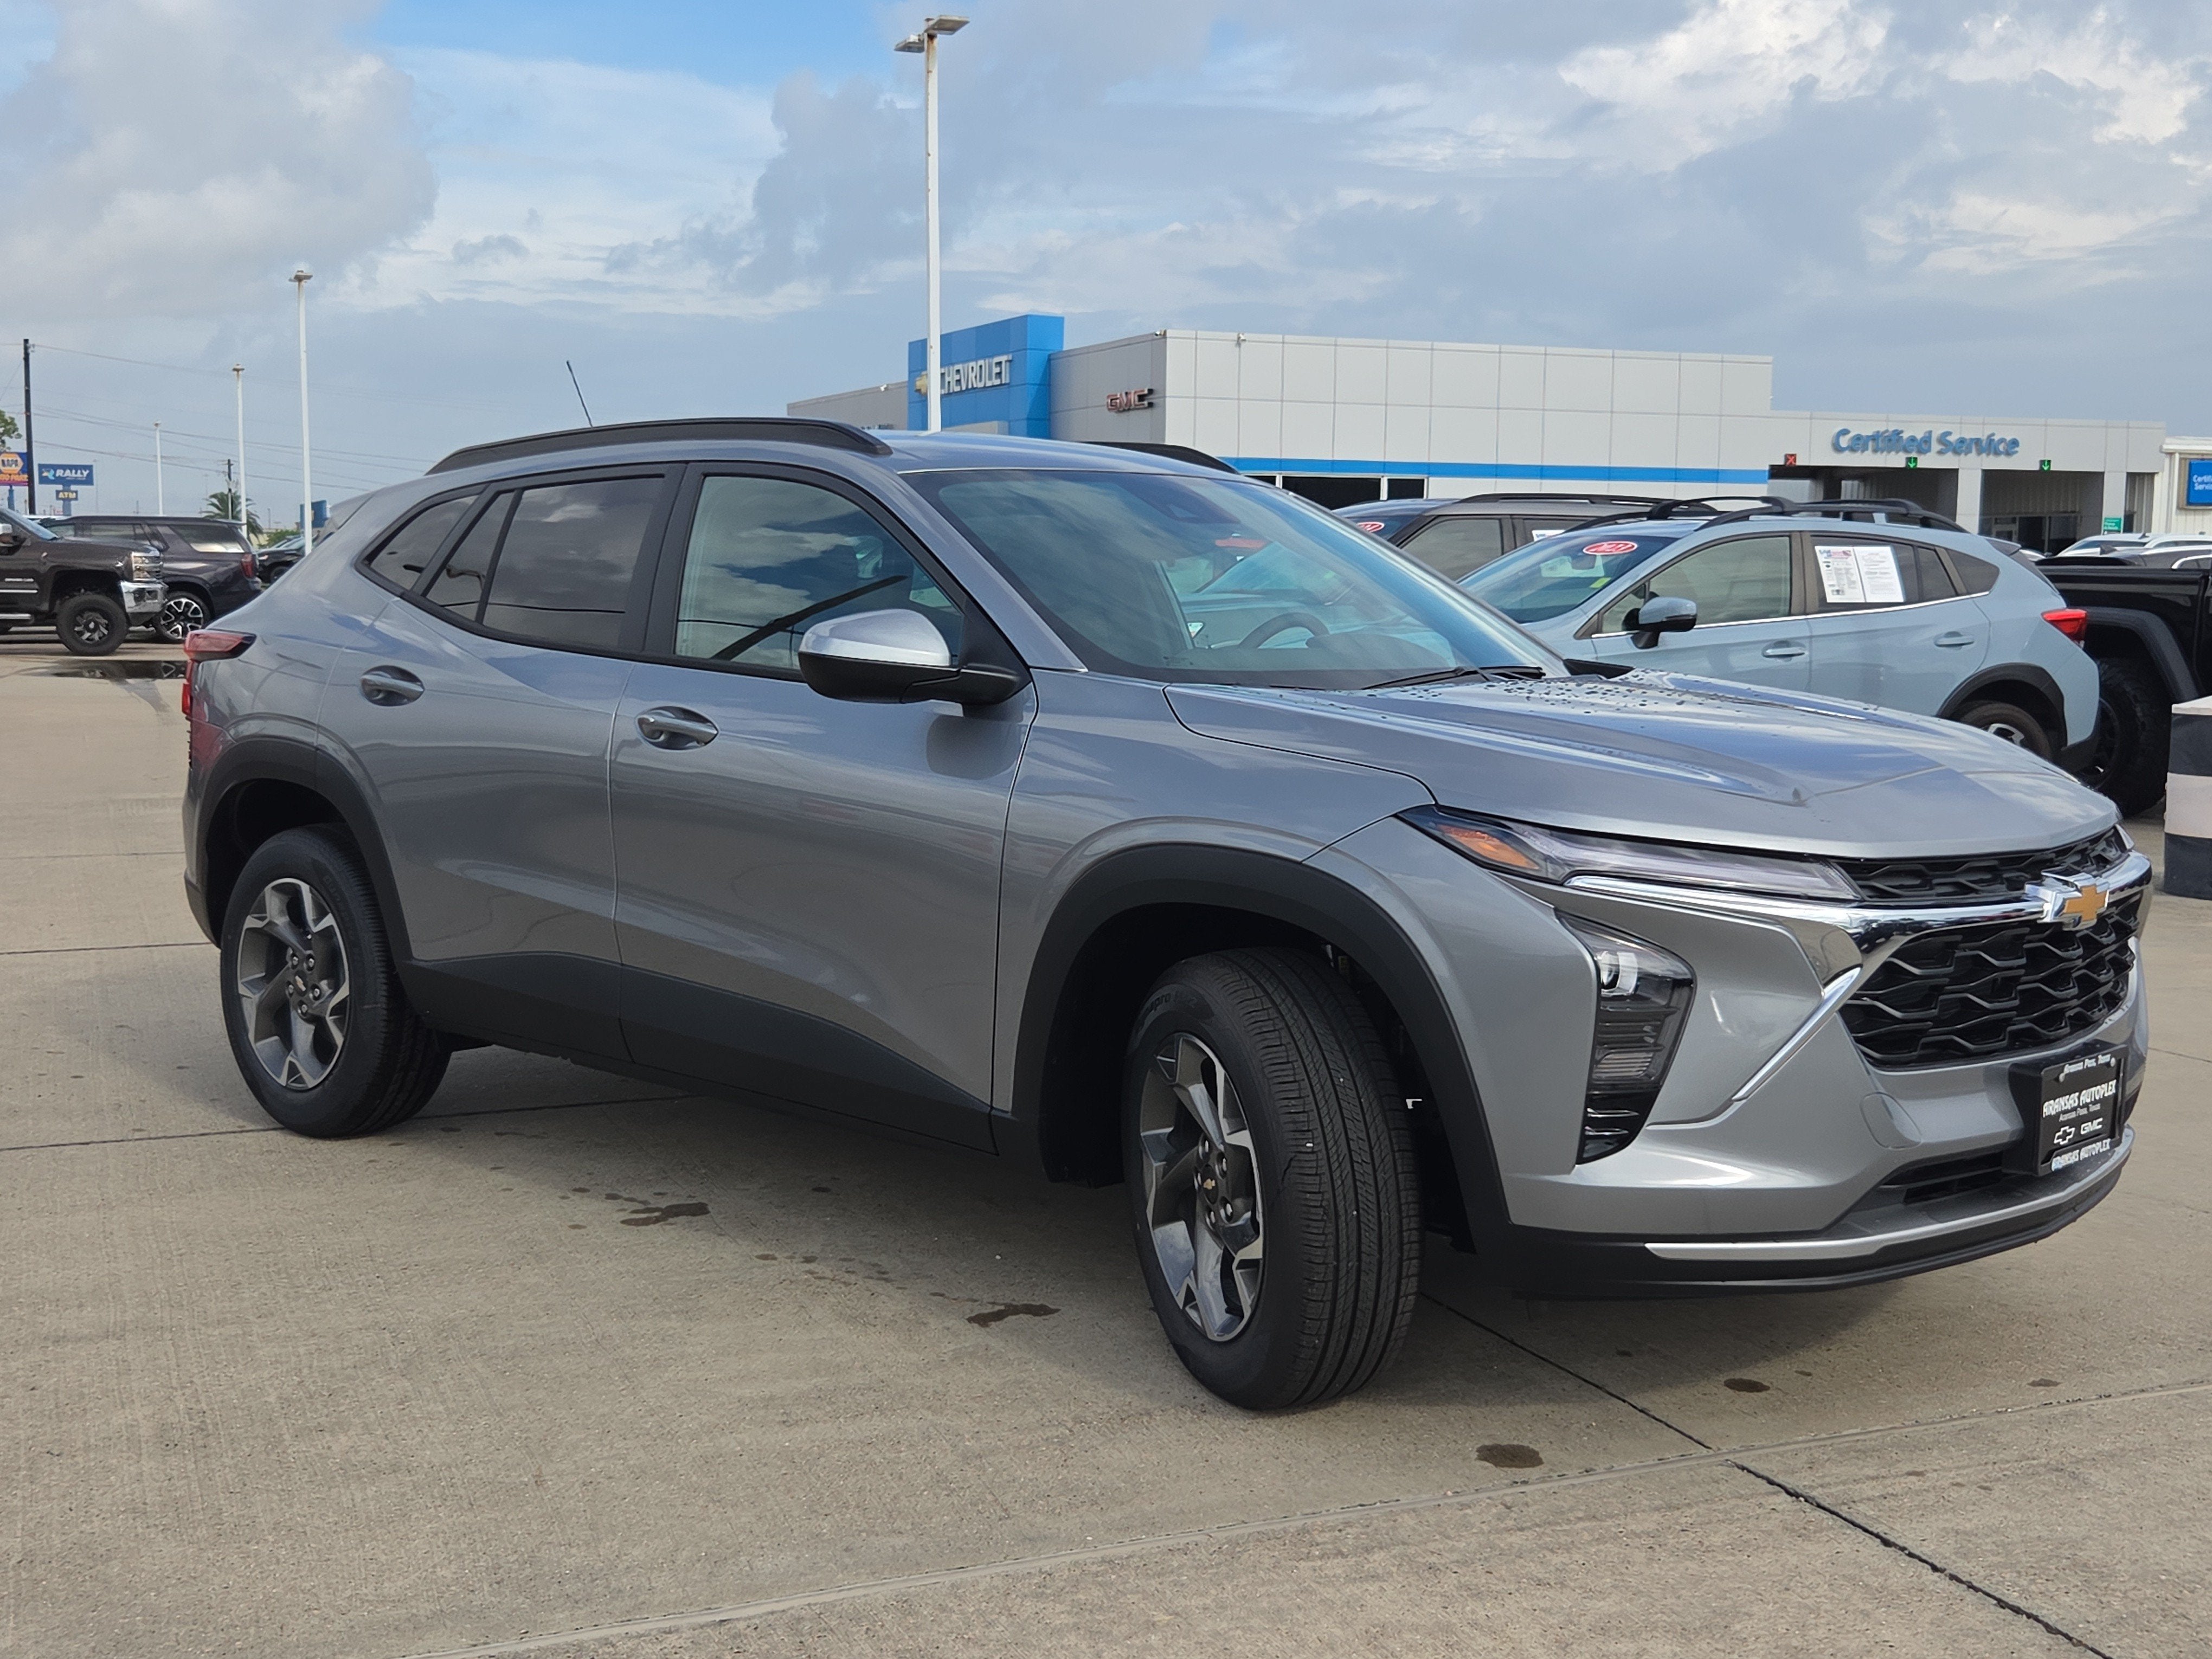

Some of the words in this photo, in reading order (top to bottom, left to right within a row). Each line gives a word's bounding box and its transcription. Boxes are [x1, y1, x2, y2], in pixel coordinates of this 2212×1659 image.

[1106, 388, 1150, 411] GMC
[1833, 428, 1932, 453] Certified
[1936, 430, 2020, 456] Service
[56, 469, 89, 477] RALLY
[2043, 1092, 2079, 1117] ARANSAS
[2080, 1079, 2117, 1105] AUTOPLEX
[2080, 1117, 2103, 1134] GMC
